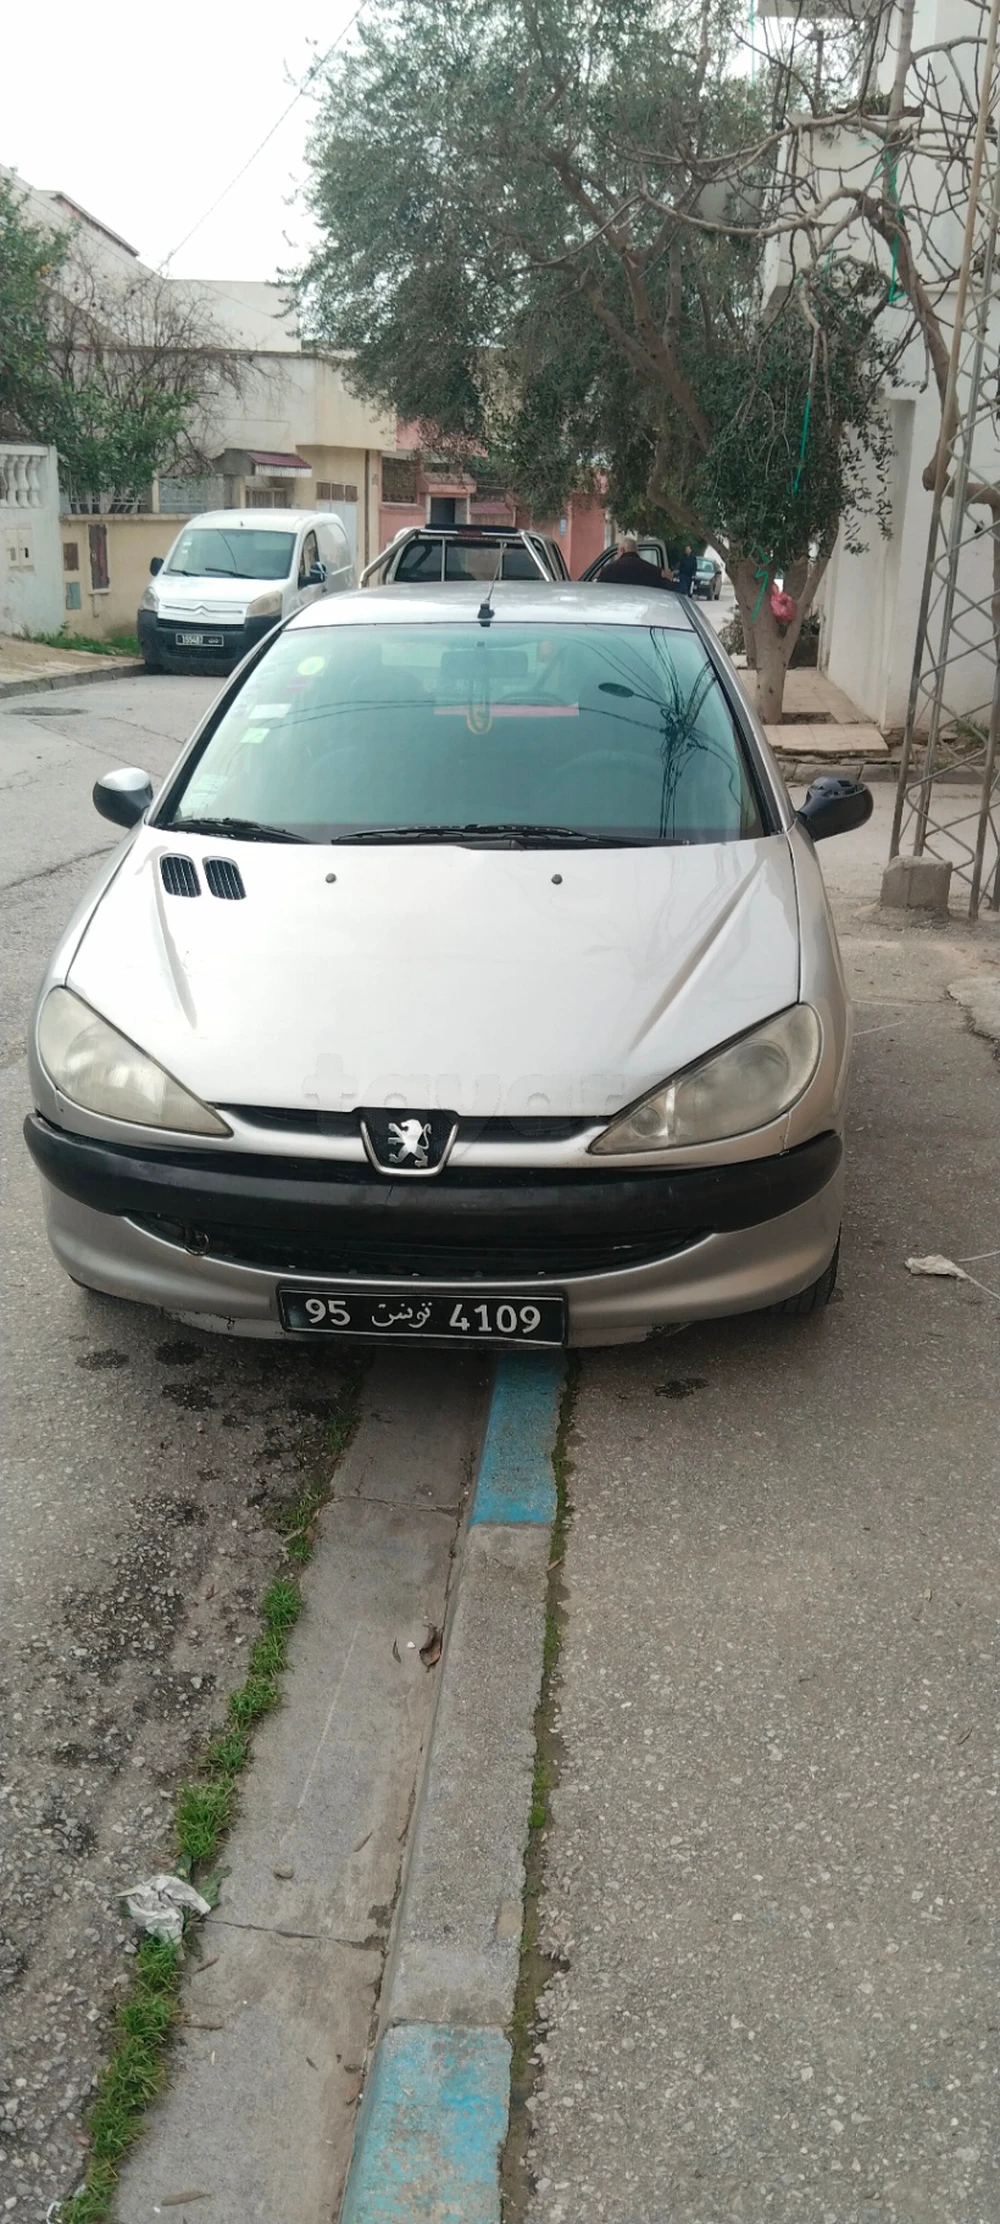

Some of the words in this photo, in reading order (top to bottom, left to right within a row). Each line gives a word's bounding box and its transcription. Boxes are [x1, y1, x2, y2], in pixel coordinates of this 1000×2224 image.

[305, 1298, 351, 1326] 95
[371, 1301, 433, 1328] تونس
[448, 1303, 541, 1334] 4109
